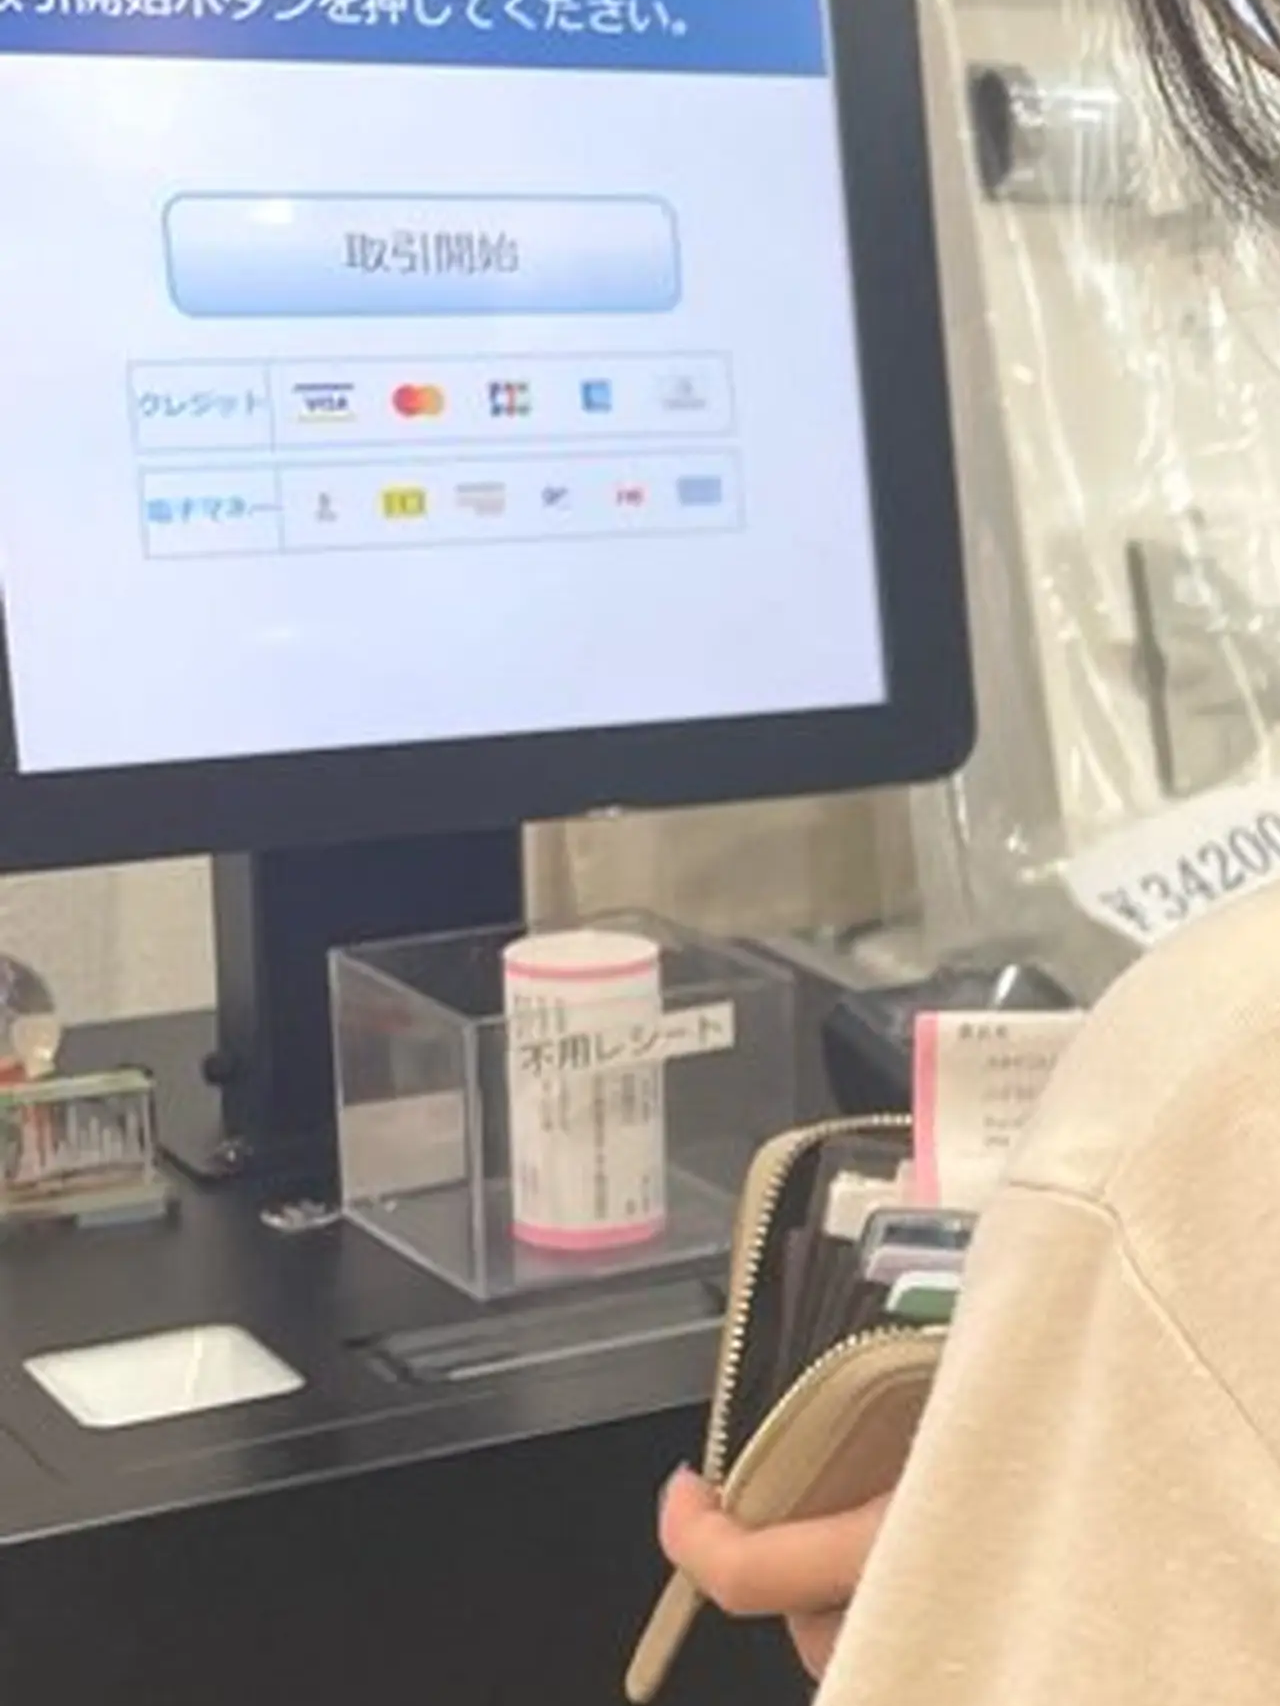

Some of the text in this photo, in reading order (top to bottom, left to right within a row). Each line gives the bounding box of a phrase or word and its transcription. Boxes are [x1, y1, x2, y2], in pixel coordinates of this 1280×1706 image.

[344, 231, 519, 276] 取引開始
[519, 1013, 724, 1079] 不用レシート
